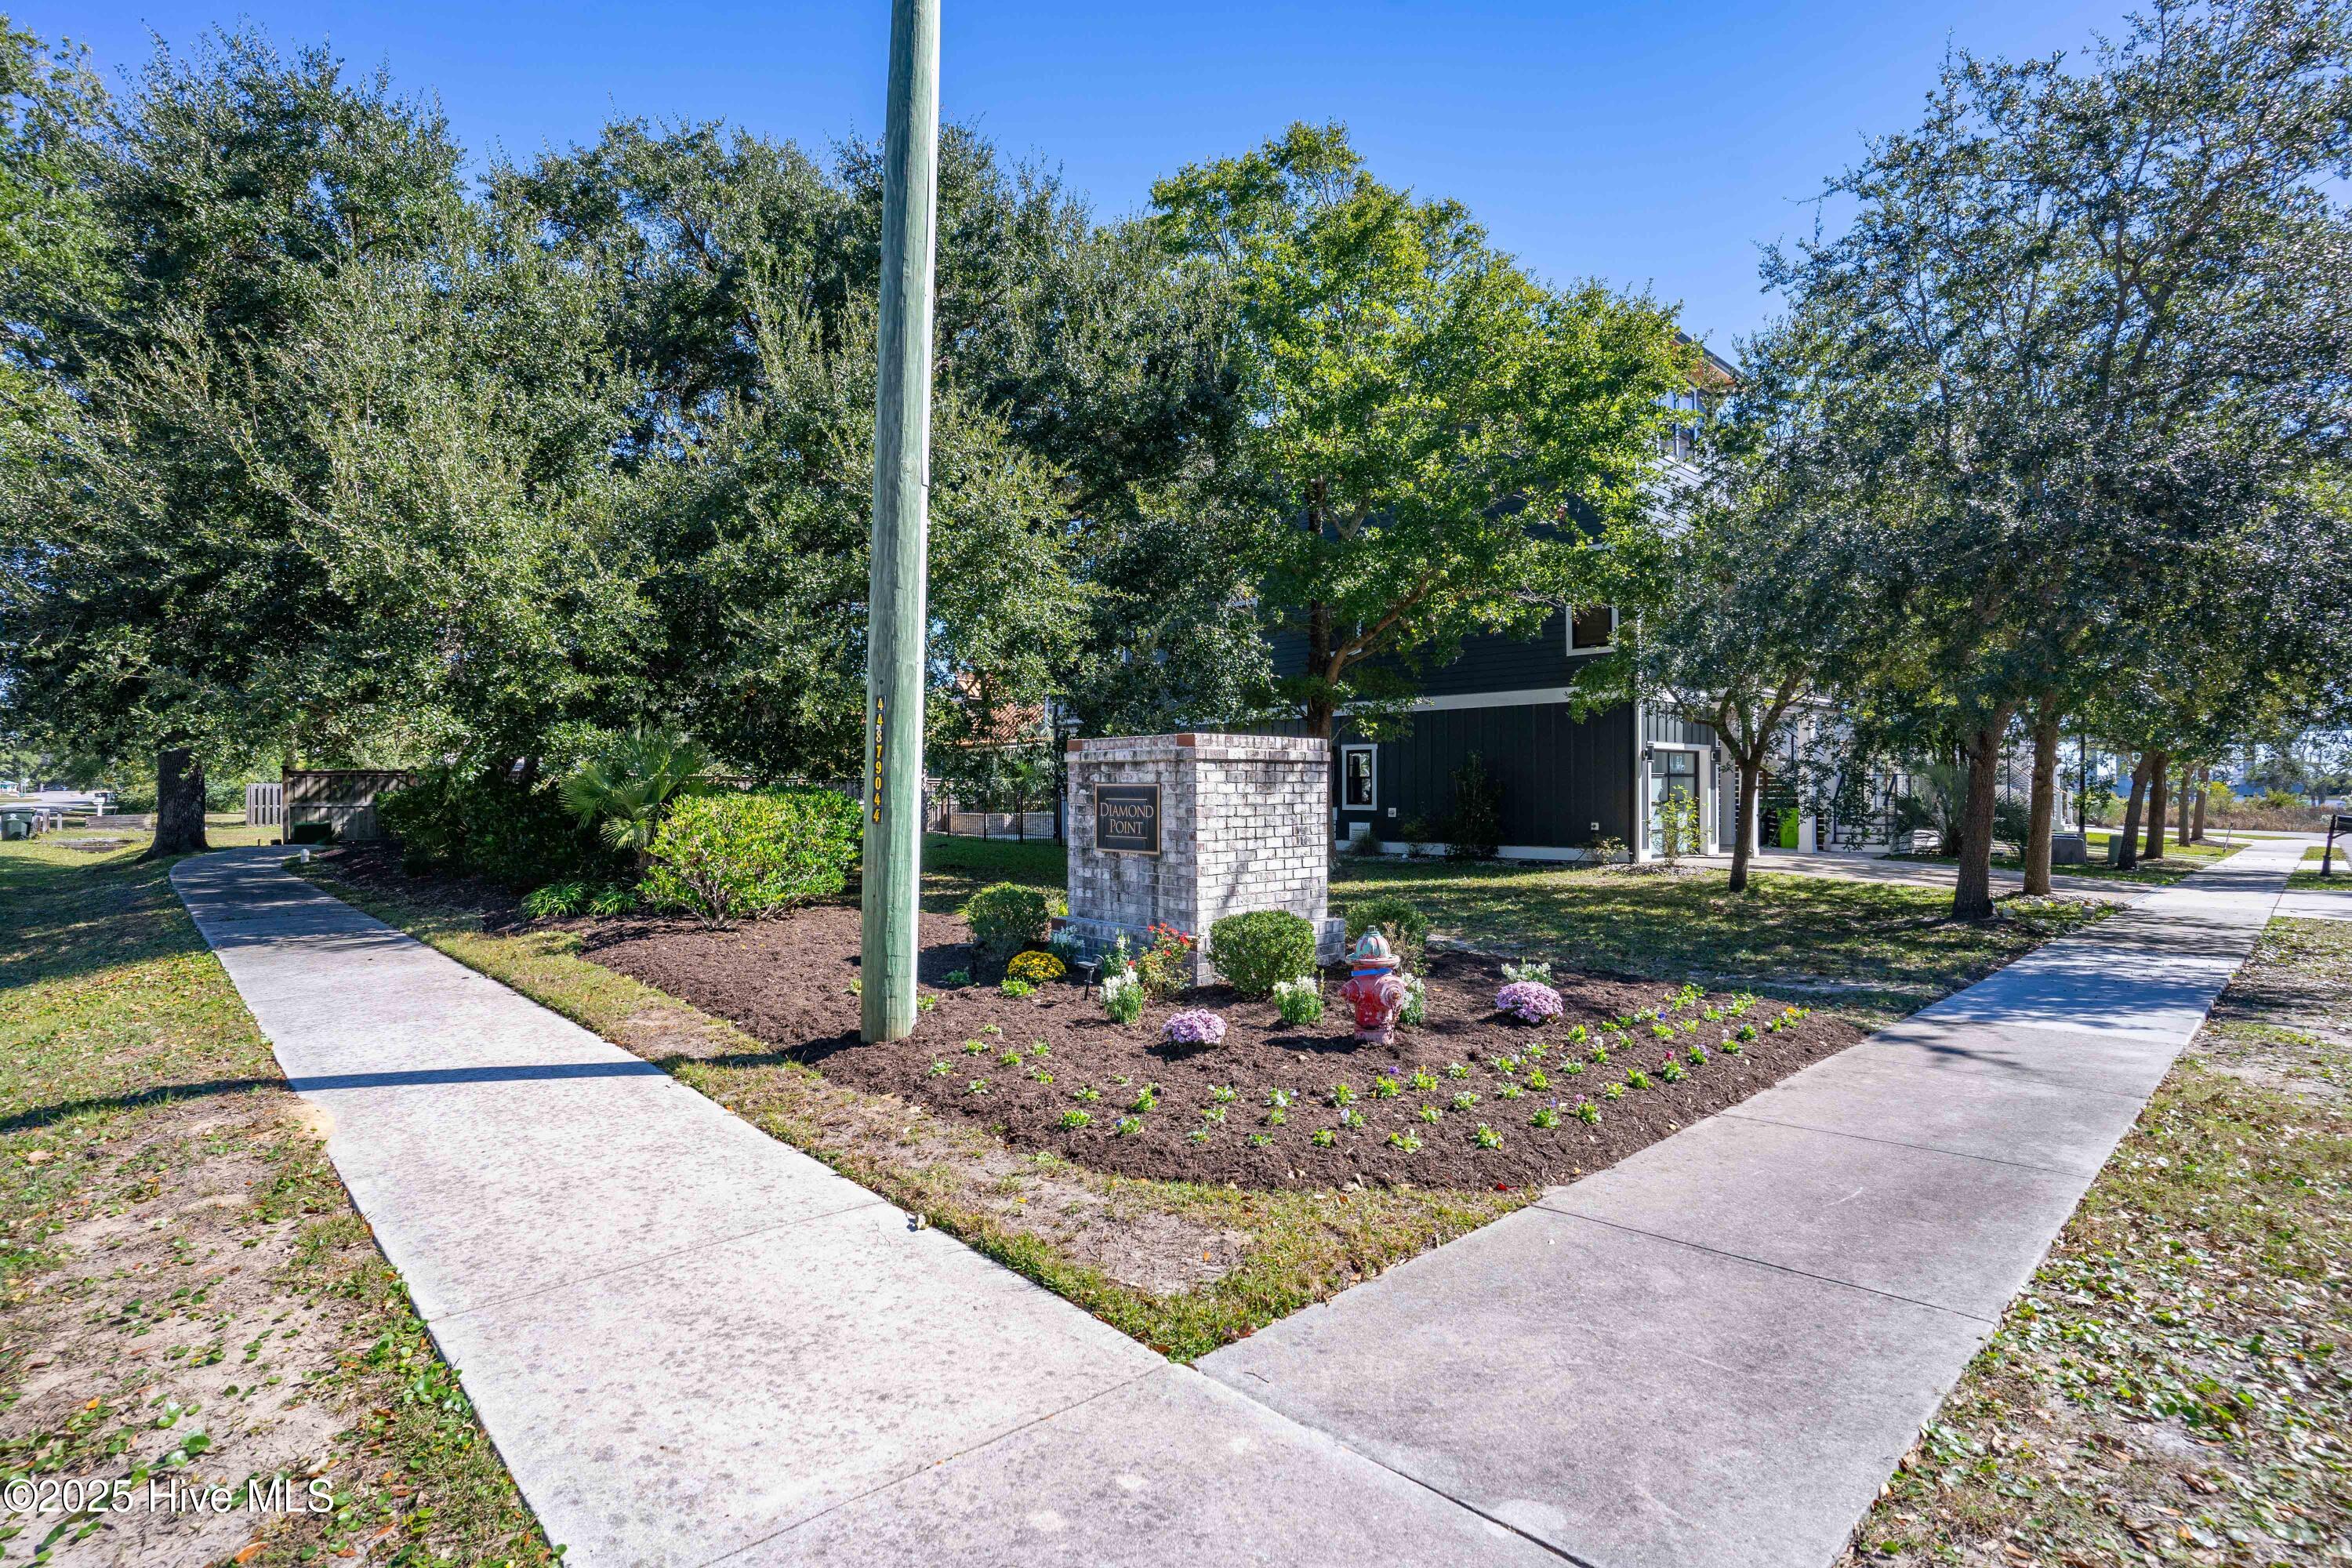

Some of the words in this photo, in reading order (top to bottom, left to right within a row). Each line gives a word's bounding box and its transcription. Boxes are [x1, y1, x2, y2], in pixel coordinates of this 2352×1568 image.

[873, 698, 884, 822] 44879044
[1100, 802, 1154, 818] DIAMOND
[1110, 818, 1143, 834] POINT
